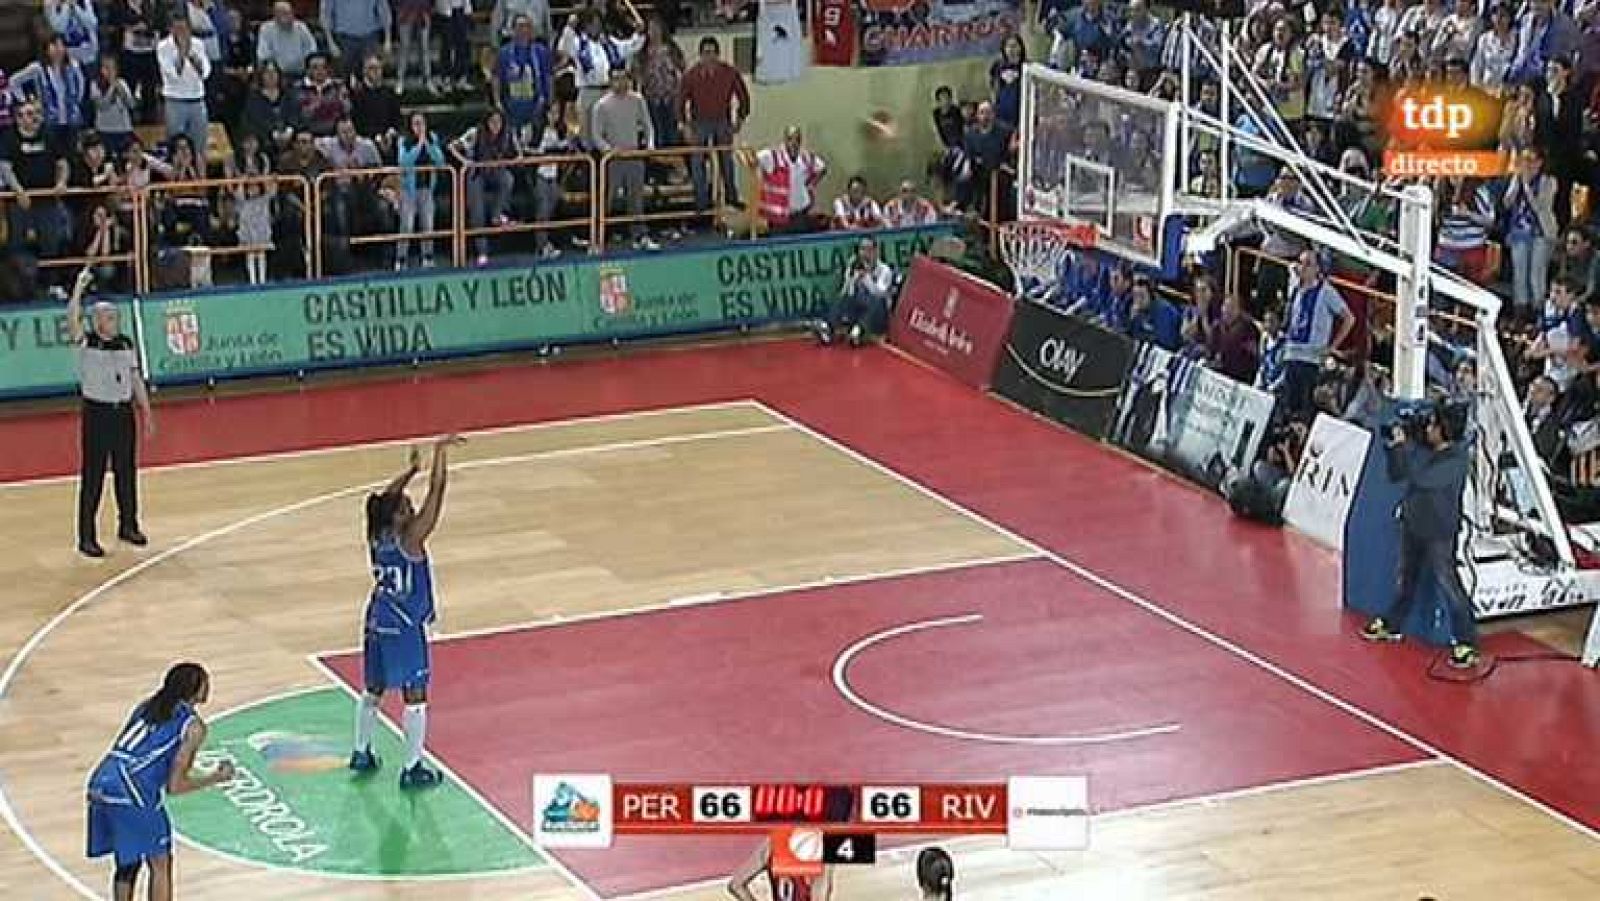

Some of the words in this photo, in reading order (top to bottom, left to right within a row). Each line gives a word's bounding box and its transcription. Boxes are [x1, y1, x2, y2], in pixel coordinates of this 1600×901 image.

[717, 245, 847, 287] CASTILLA
[303, 281, 453, 324] CASTILLA
[462, 279, 481, 309] Y
[492, 266, 567, 307] LEÓN
[720, 290, 753, 320] ES
[761, 283, 828, 318] VIDA
[0, 316, 20, 350] Y
[307, 330, 345, 361] ES
[354, 323, 432, 356] VIDA
[192, 740, 330, 863] BERDROLA
